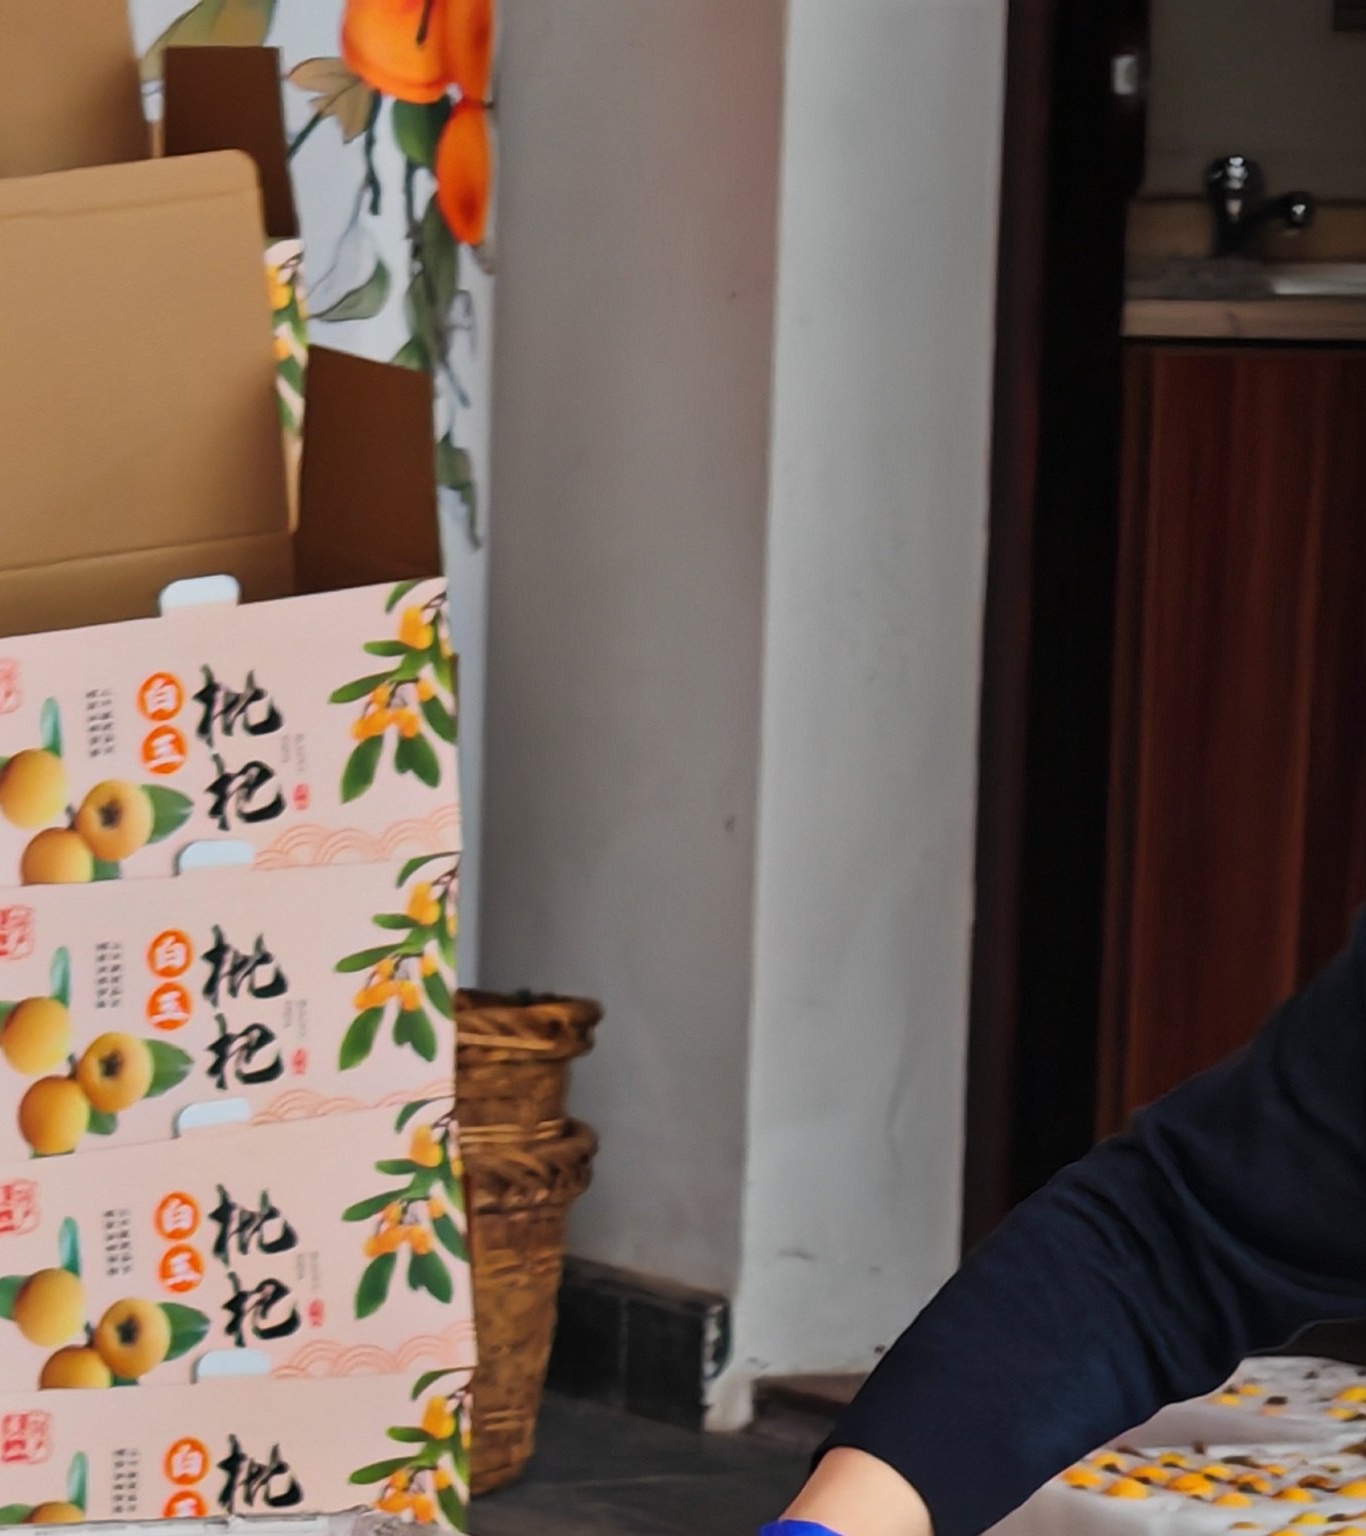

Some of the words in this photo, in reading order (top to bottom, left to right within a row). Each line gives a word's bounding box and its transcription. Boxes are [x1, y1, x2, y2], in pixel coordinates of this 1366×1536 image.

[192, 663, 286, 832] 枇杷
[199, 924, 289, 1090] 枇杷
[207, 1183, 301, 1347] 枇杷
